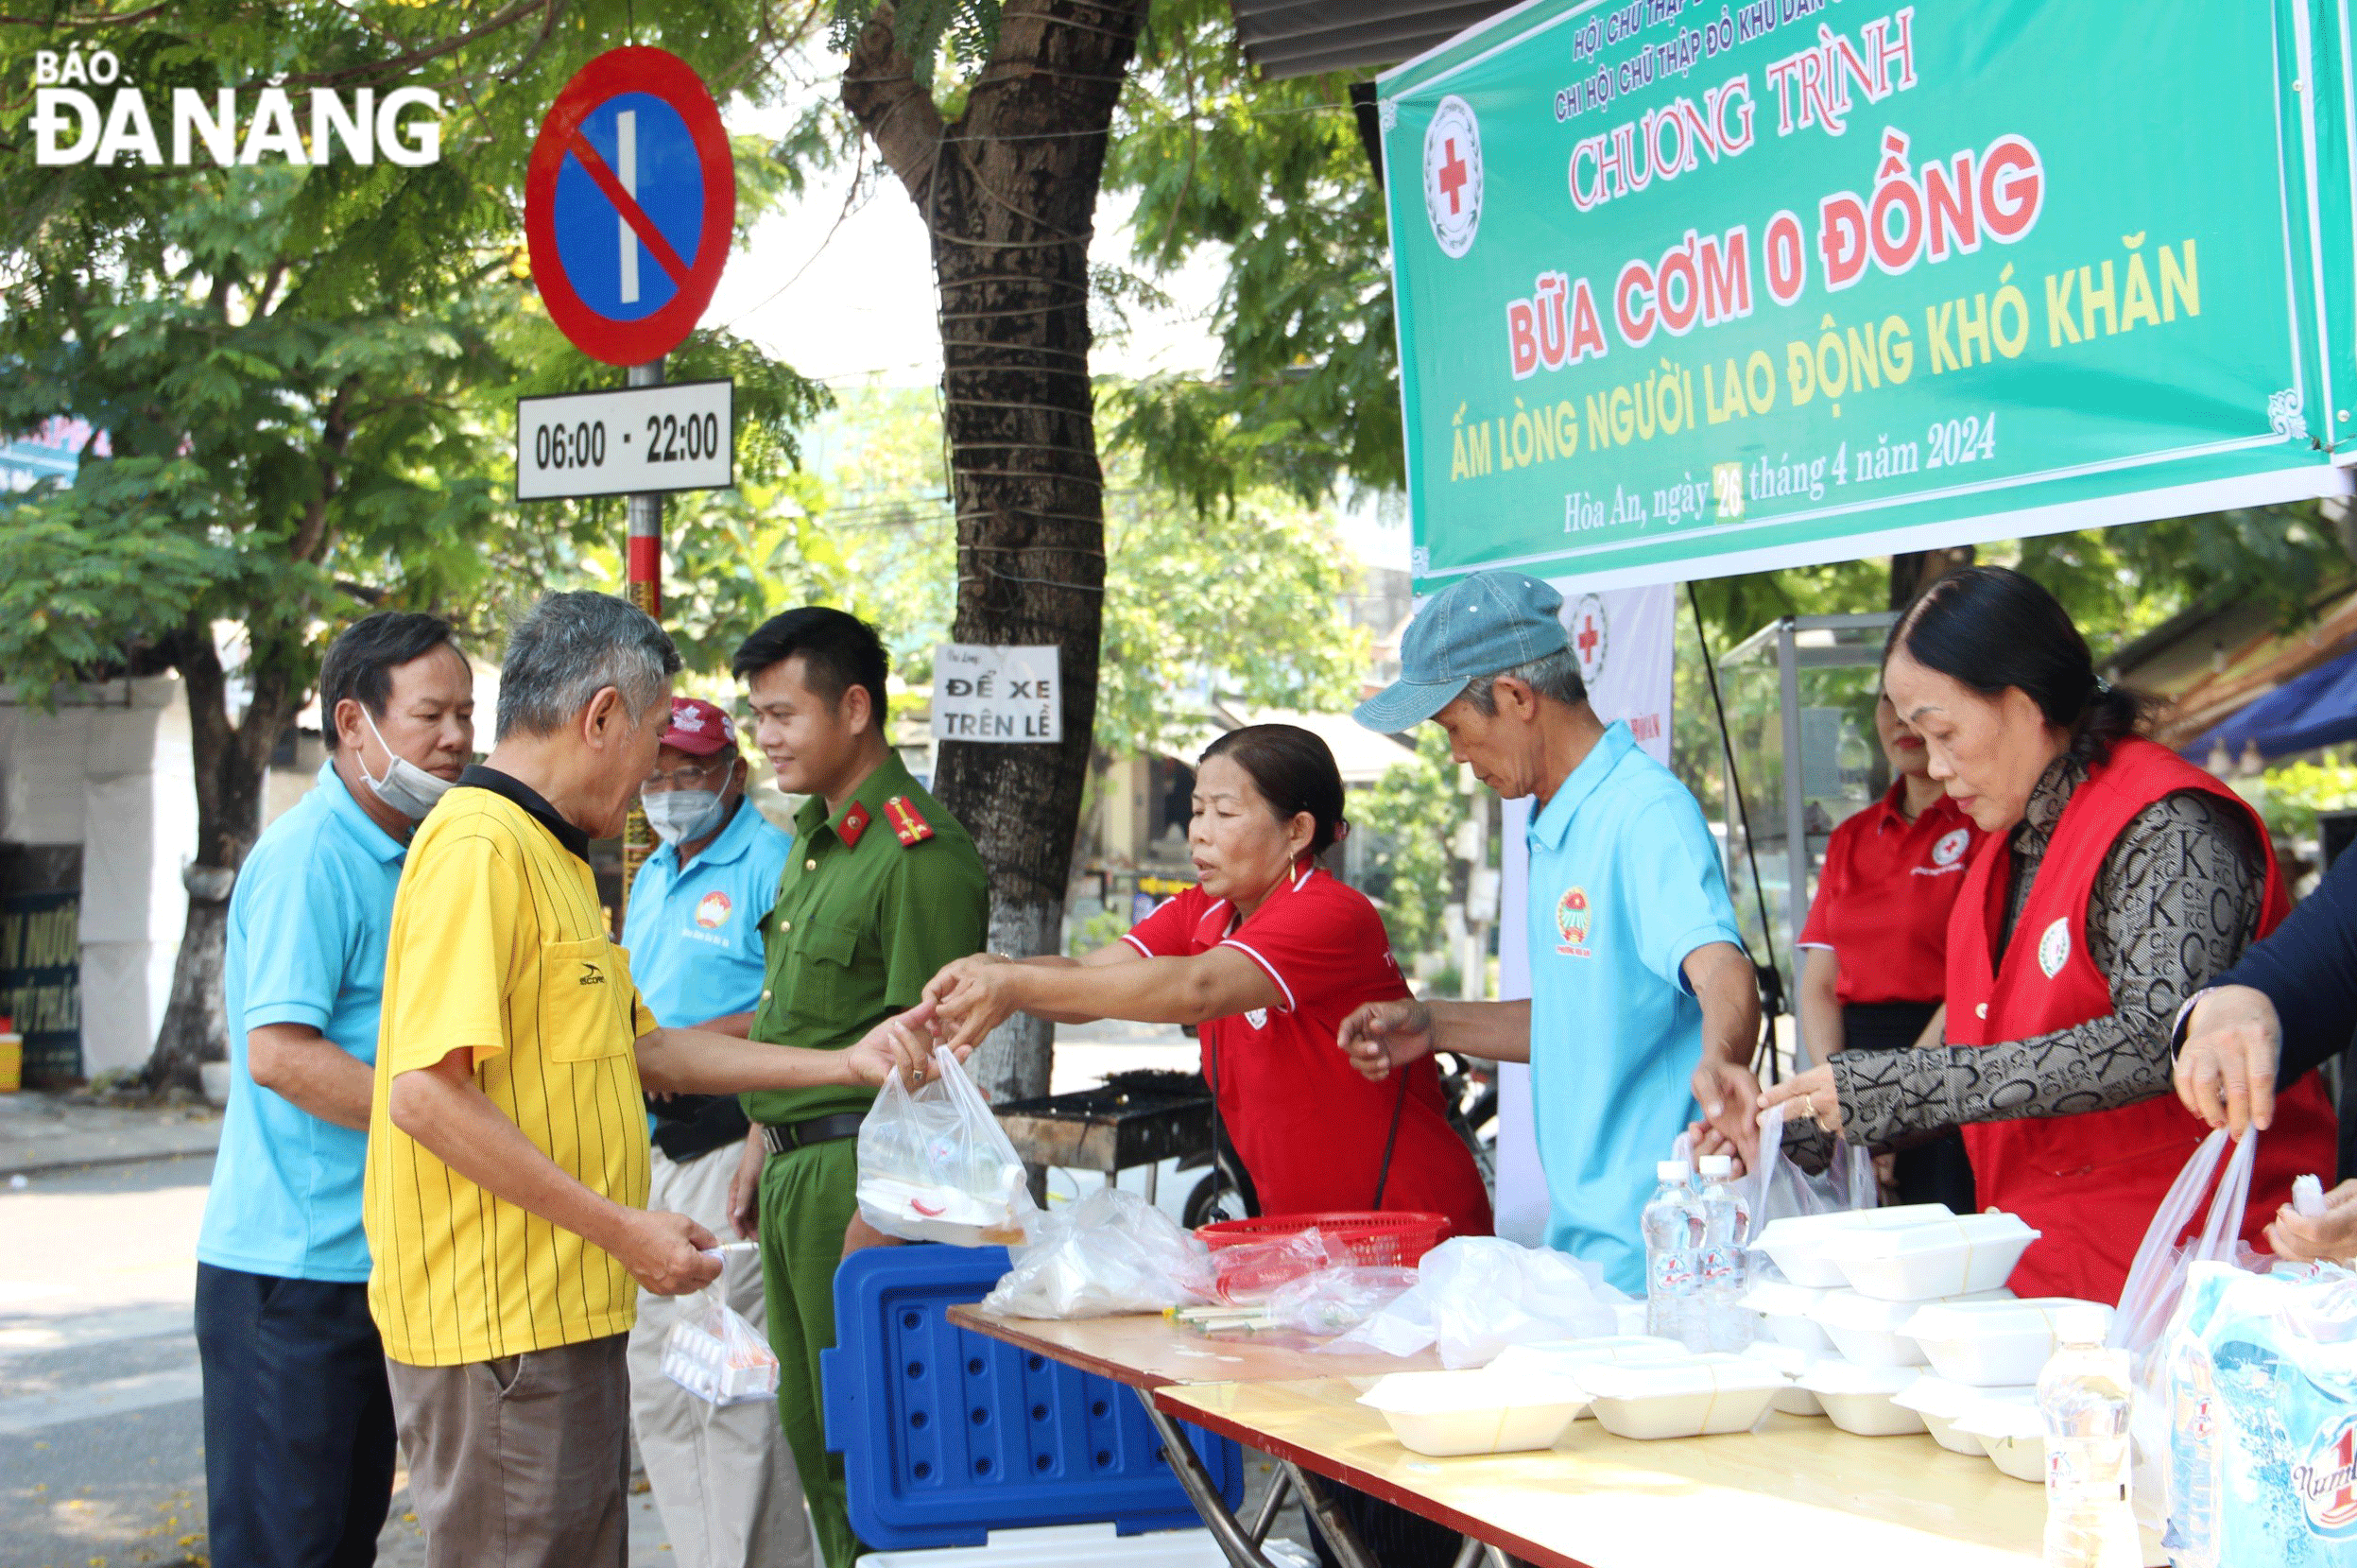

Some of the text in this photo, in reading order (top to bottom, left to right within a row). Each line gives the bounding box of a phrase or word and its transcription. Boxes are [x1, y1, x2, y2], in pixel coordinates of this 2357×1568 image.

[1555, 85, 1582, 121] CHI
[1585, 63, 1615, 112] HỘI
[1618, 45, 1654, 94] CHỮ
[1658, 27, 1700, 78] THẬP
[1705, 5, 1733, 57] ĐỎ
[1738, 0, 1777, 43] KHU
[1573, 16, 1604, 62] HỘI
[1569, 8, 1917, 212] CHƯƠNG TRÌNH
[1507, 270, 1608, 380] BỮA
[1615, 227, 1754, 348] CƠM
[1818, 126, 2045, 292] ĐỒNG
[1499, 396, 1578, 471] LÒNG
[1586, 357, 1695, 452] NGƯỜI
[1704, 350, 1777, 425] LAO
[1786, 313, 1914, 419] ĐỘNG
[1925, 261, 2030, 375] KHÓ
[2044, 231, 2202, 350] KHĂN
[537, 421, 606, 470] 06:00
[646, 412, 718, 463] 22:00
[1564, 491, 1606, 534] Hòa
[1609, 483, 1647, 529] An,
[1653, 471, 1711, 526] ngày
[1749, 452, 1826, 503] tháng
[1831, 441, 1849, 486] 4
[1856, 432, 1919, 484] năm
[1925, 412, 1997, 470] 2024
[944, 708, 1013, 737] TRÊN
[1009, 680, 1051, 699] XE
